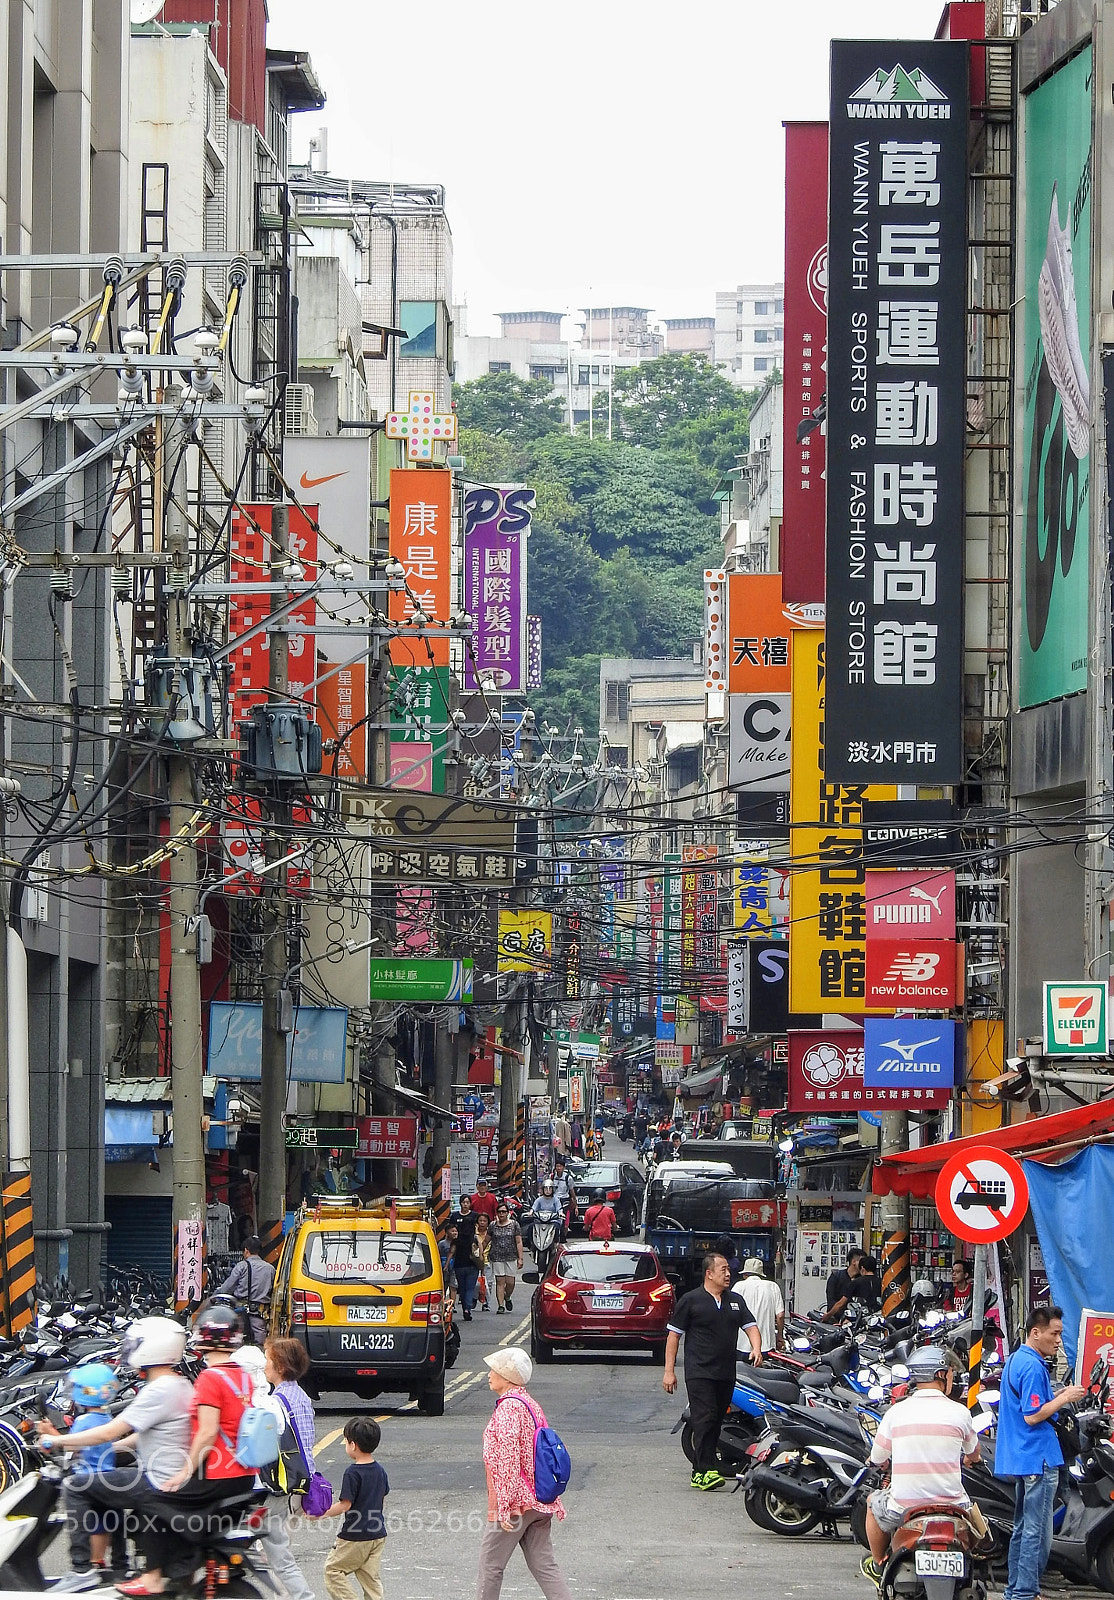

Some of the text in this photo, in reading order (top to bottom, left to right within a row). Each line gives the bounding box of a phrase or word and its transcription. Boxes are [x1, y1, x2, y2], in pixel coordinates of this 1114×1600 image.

[847, 104, 951, 119] WANN YUEH
[848, 140, 869, 684] WANN YUEH SPORTS & FASHION STORE
[873, 141, 942, 686] 萬岳運動時尚館
[472, 548, 480, 610] INTERNATIONAL
[483, 548, 512, 661] 國際髮型
[732, 637, 788, 667] 天禧
[738, 747, 788, 763] Make
[848, 741, 937, 764] 淡水門市
[347, 799, 392, 825] DK
[868, 828, 947, 841] CONVERSE
[372, 852, 507, 877] 呼吸空氣鞋
[873, 904, 932, 924] PUMA
[871, 984, 949, 996] new balance
[1057, 1018, 1096, 1030] ELEVEN
[370, 1121, 400, 1136] 星智
[476, 1128, 491, 1139] SALE
[360, 1140, 411, 1154] 運動世界
[326, 1263, 402, 1272] 0809-000-258
[341, 1334, 395, 1350] RAL-3225
